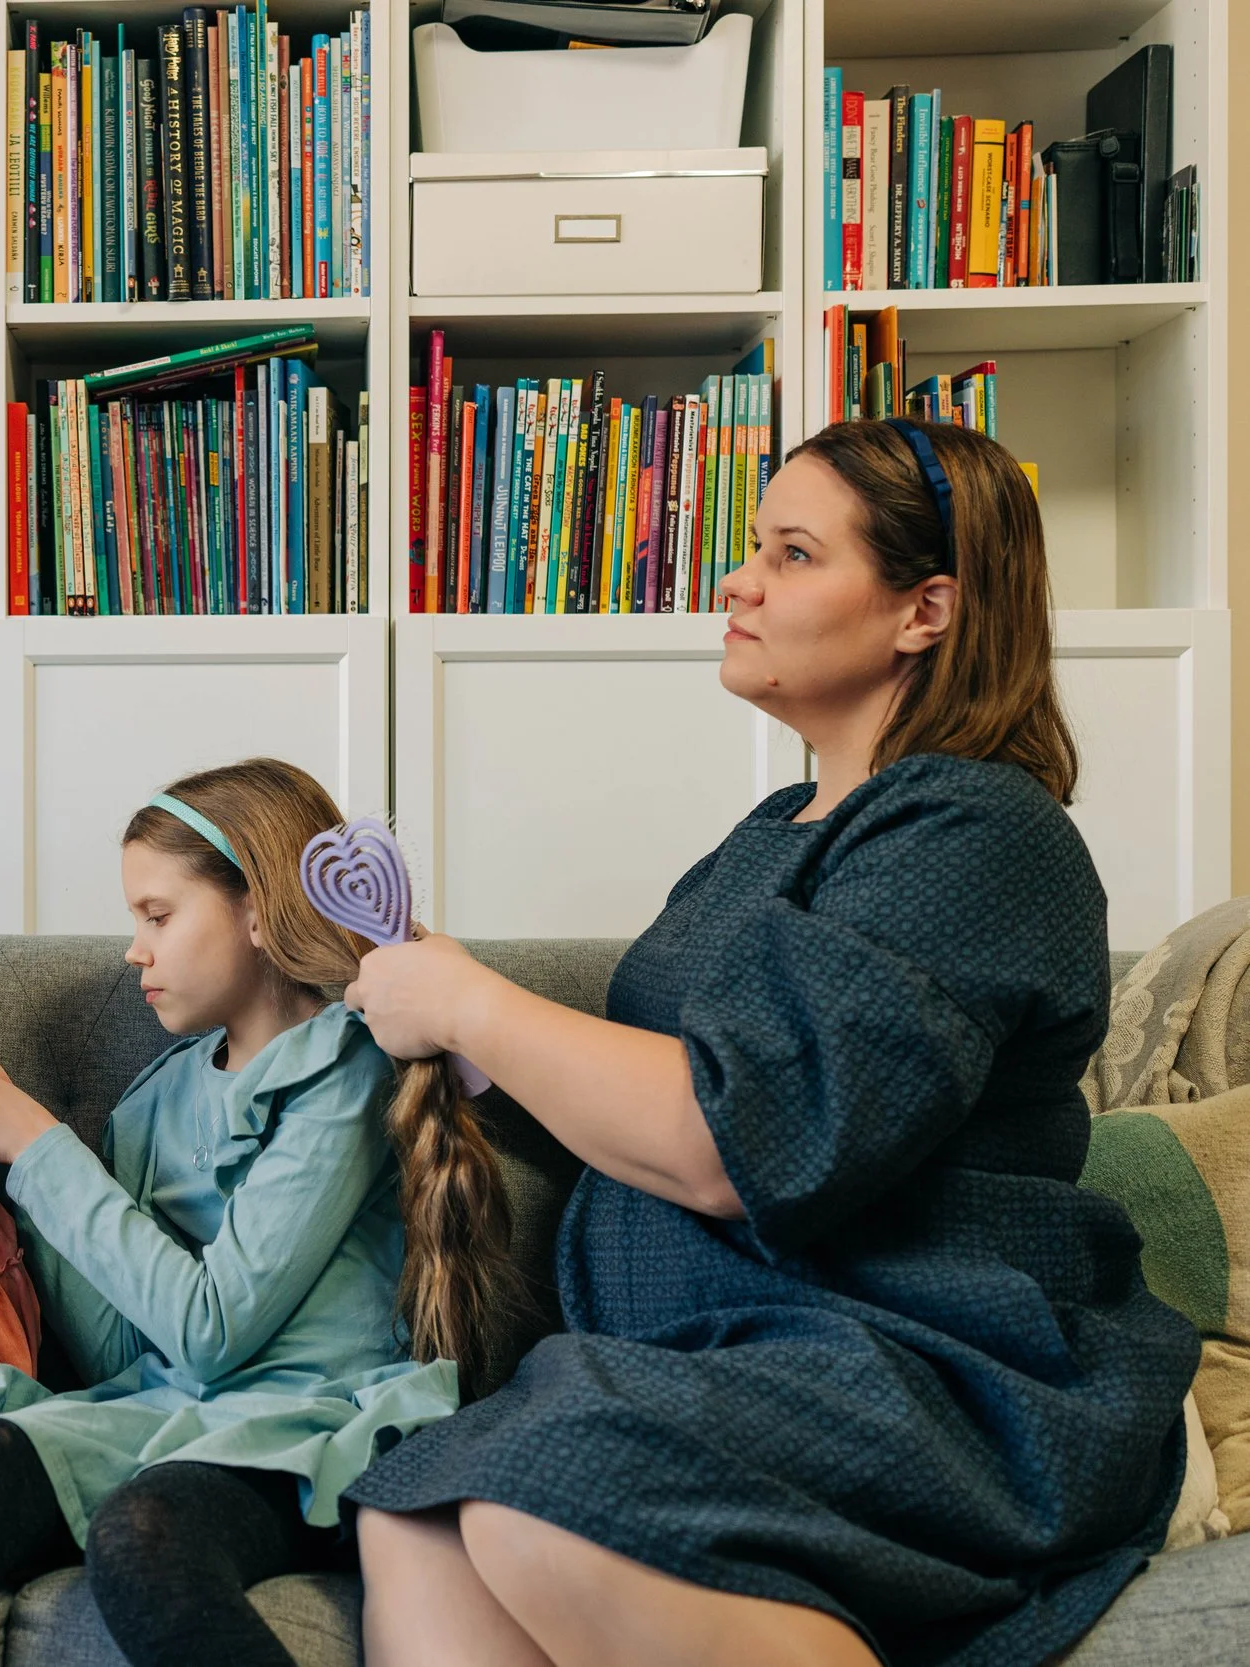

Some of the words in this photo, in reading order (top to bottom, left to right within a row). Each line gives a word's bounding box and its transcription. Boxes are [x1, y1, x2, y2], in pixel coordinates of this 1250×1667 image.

[42, 84, 50, 114] Willems
[192, 95, 202, 110] THE
[897, 96, 906, 114] The
[104, 108, 115, 148] KIRAHVIN
[168, 99, 182, 173] HISTORY
[192, 112, 202, 137] TALES
[847, 127, 858, 144] HAVE
[869, 126, 878, 146] Fancy
[896, 116, 906, 153] Finders
[918, 108, 928, 147] Invisible
[144, 133, 154, 165] STORIES
[193, 139, 203, 150] OF
[847, 145, 858, 157] TO
[869, 149, 878, 163] Bear
[105, 151, 117, 176] SYDÄN
[193, 151, 204, 181] BEEDLE
[846, 159, 858, 179] MAKE
[869, 165, 878, 182] Goes
[917, 150, 927, 193] Influence
[985, 152, 994, 193] WORST-CASE
[105, 178, 115, 192] ON
[170, 179, 183, 196] OF
[194, 183, 204, 198] THE
[895, 184, 903, 198] DR.
[195, 200, 205, 221] BARD
[868, 184, 878, 213] Phishing
[105, 195, 116, 244] TAVATTOMAN
[171, 200, 184, 256] MAGIC
[894, 199, 902, 237] JEFFERY
[894, 238, 901, 247] A.
[105, 248, 116, 273] SUURI
[893, 249, 901, 282] MARTIN
[290, 389, 298, 443] TAIKAMAAN
[411, 412, 423, 441] SEX
[100, 420, 108, 455] JOYCE
[290, 445, 298, 483] AAPINEN
[579, 442, 587, 467] JOKES
[523, 494, 530, 503] IN
[704, 505, 711, 513] IN
[105, 501, 113, 533] buddy
[412, 494, 422, 532] WORD
[521, 522, 529, 539] HAT
[703, 524, 711, 550] BOOK!
[491, 535, 506, 572] LEIPOO
